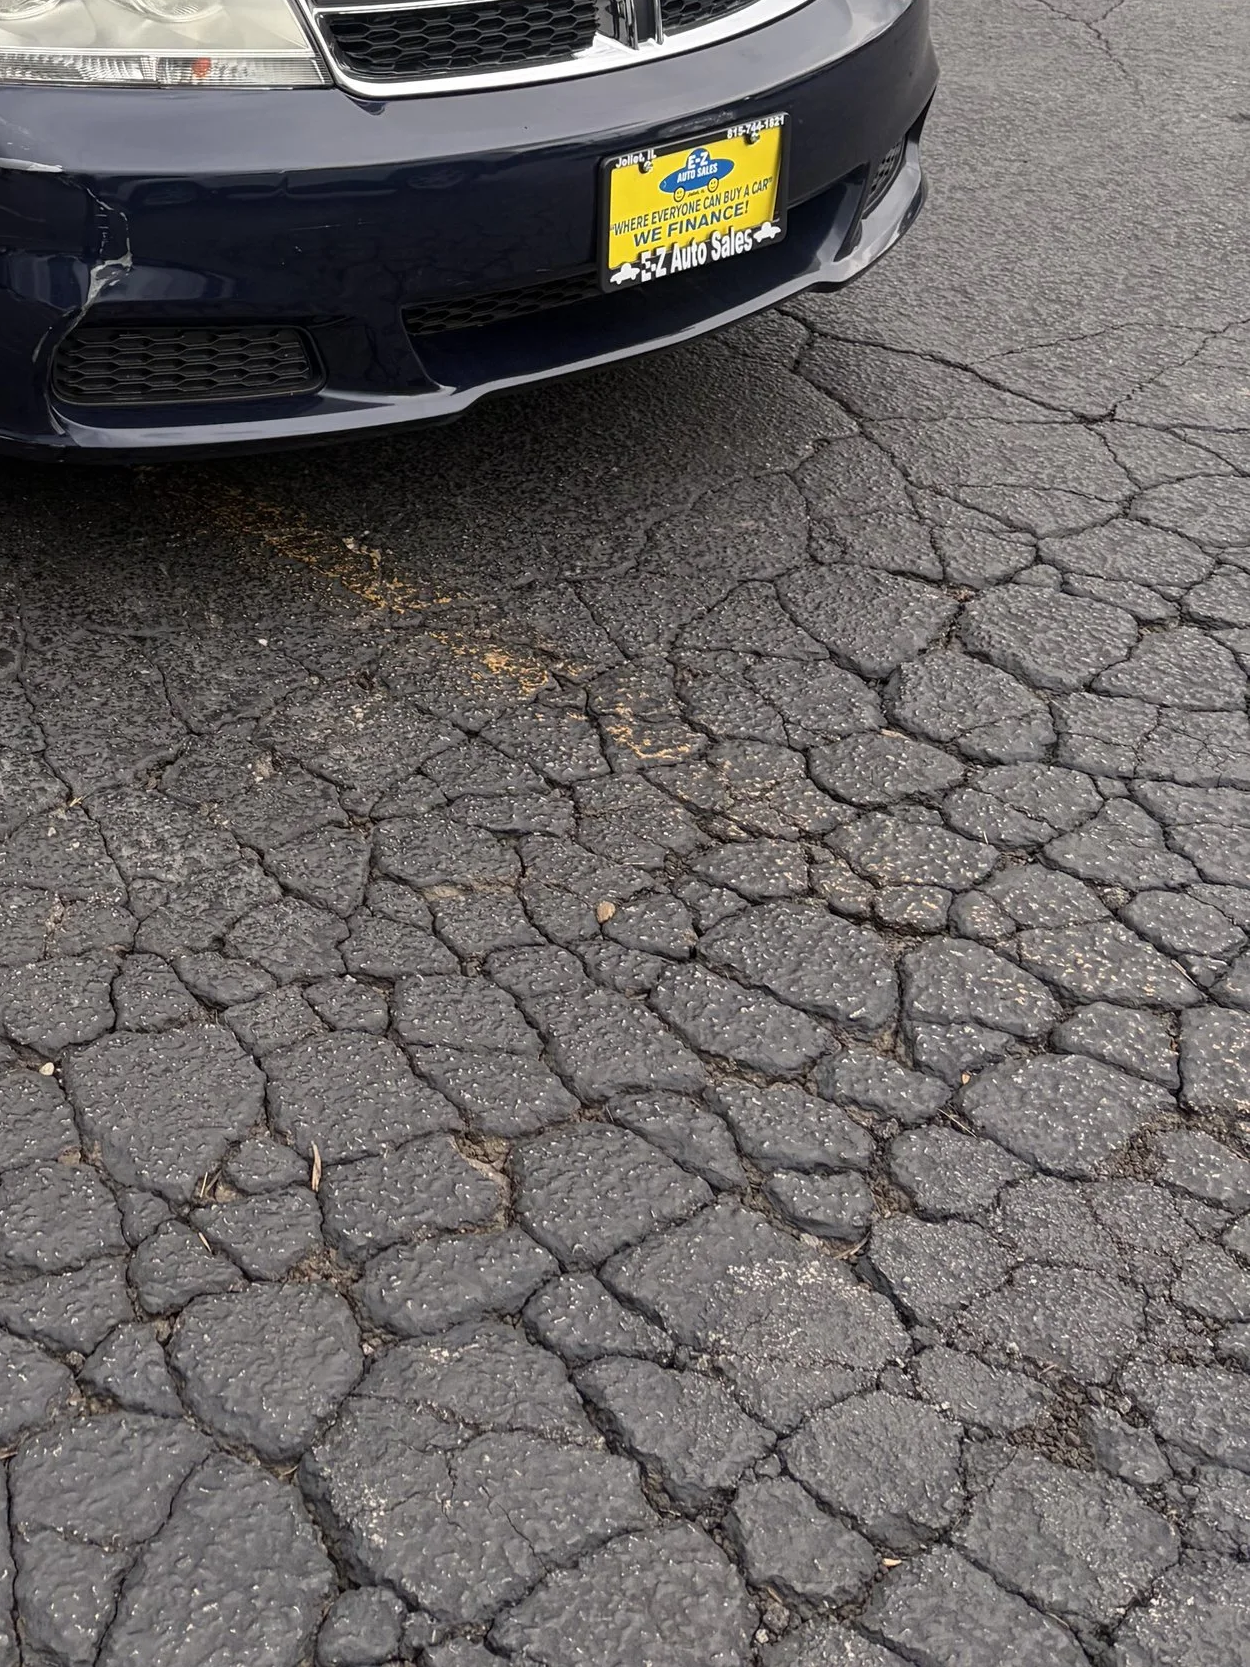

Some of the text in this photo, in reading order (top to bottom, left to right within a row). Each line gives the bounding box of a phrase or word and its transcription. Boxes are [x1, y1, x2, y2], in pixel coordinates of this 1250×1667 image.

[726, 115, 786, 139] 815-744-1821
[647, 149, 657, 159] IL
[687, 151, 709, 169] E-Z
[676, 162, 718, 184] AUTO SALES
[651, 199, 701, 224] EVERYONE
[703, 193, 721, 211] CAN
[723, 188, 742, 204] BUY
[743, 184, 750, 198] A
[633, 200, 749, 247] WE FINANCE!
[640, 227, 753, 283] E-Z Auto Sales
